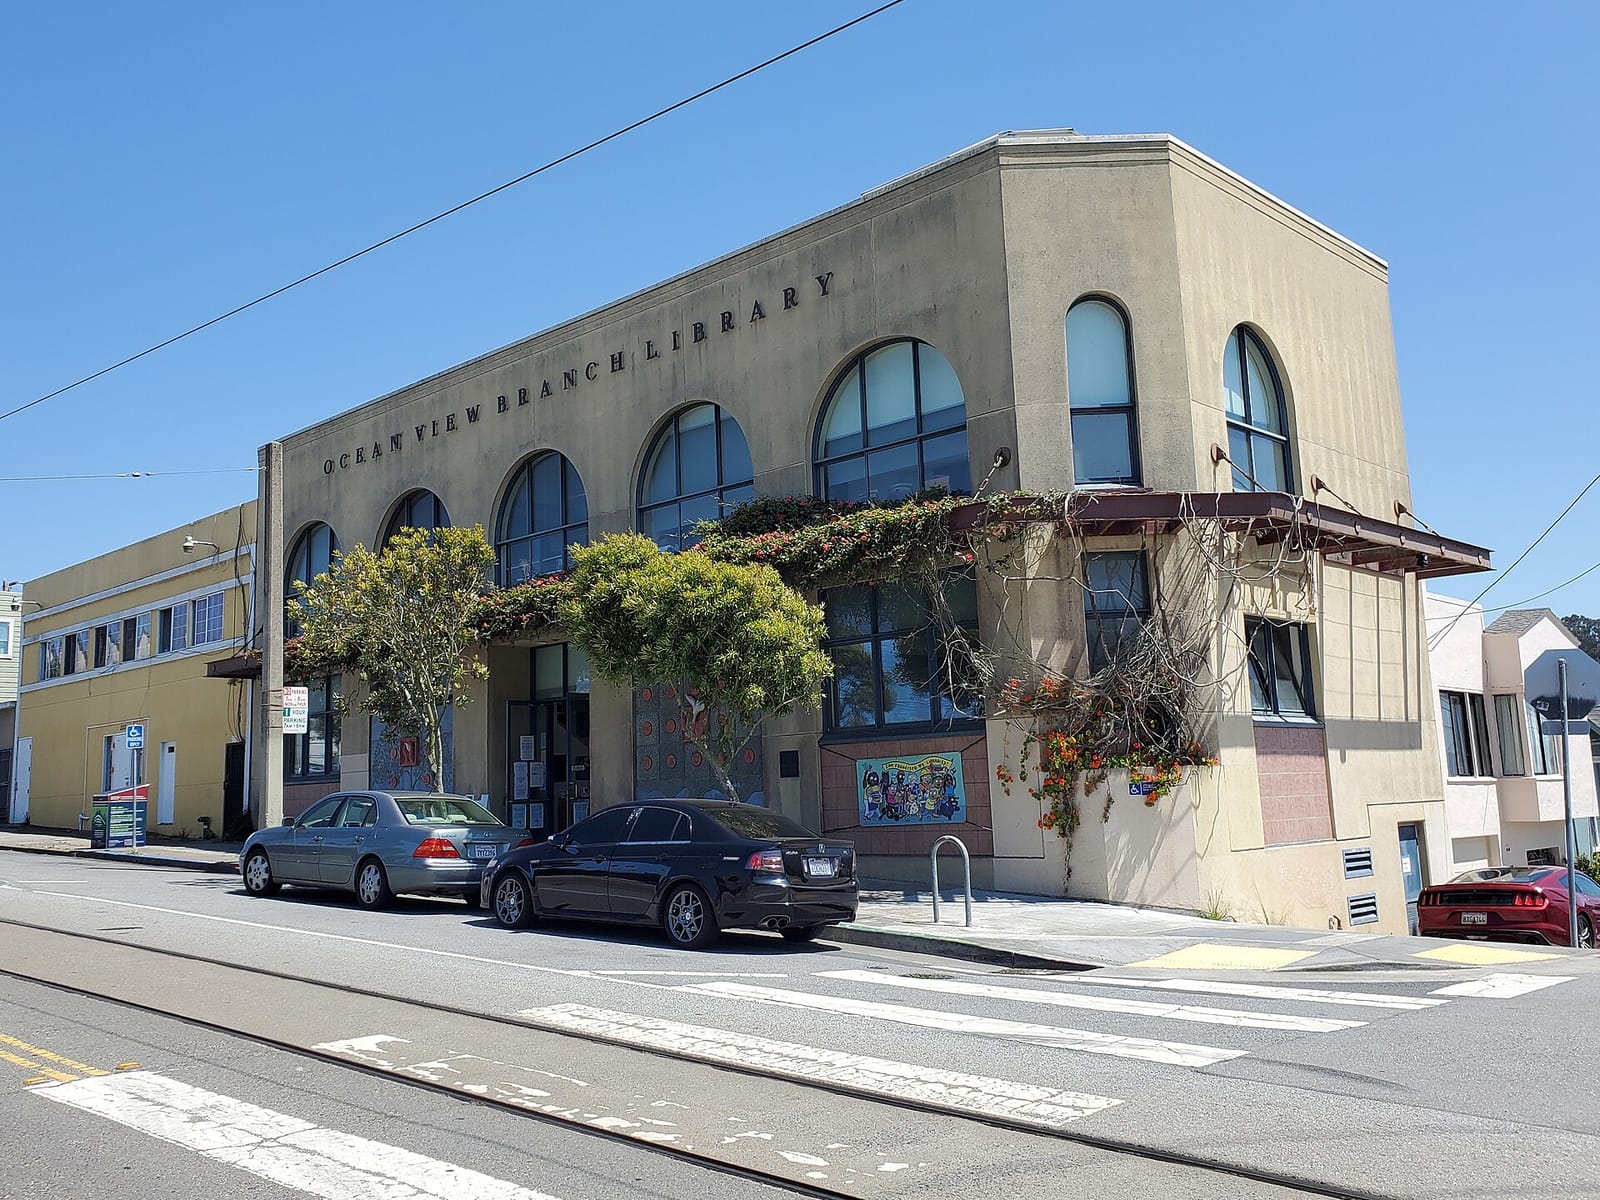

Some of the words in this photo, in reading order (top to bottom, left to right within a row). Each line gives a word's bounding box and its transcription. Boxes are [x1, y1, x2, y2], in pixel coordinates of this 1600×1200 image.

[323, 432, 402, 475] OCEAN
[414, 403, 481, 443] VIEW
[496, 351, 625, 415] BRANCH
[645, 271, 834, 361] LIBRARY
